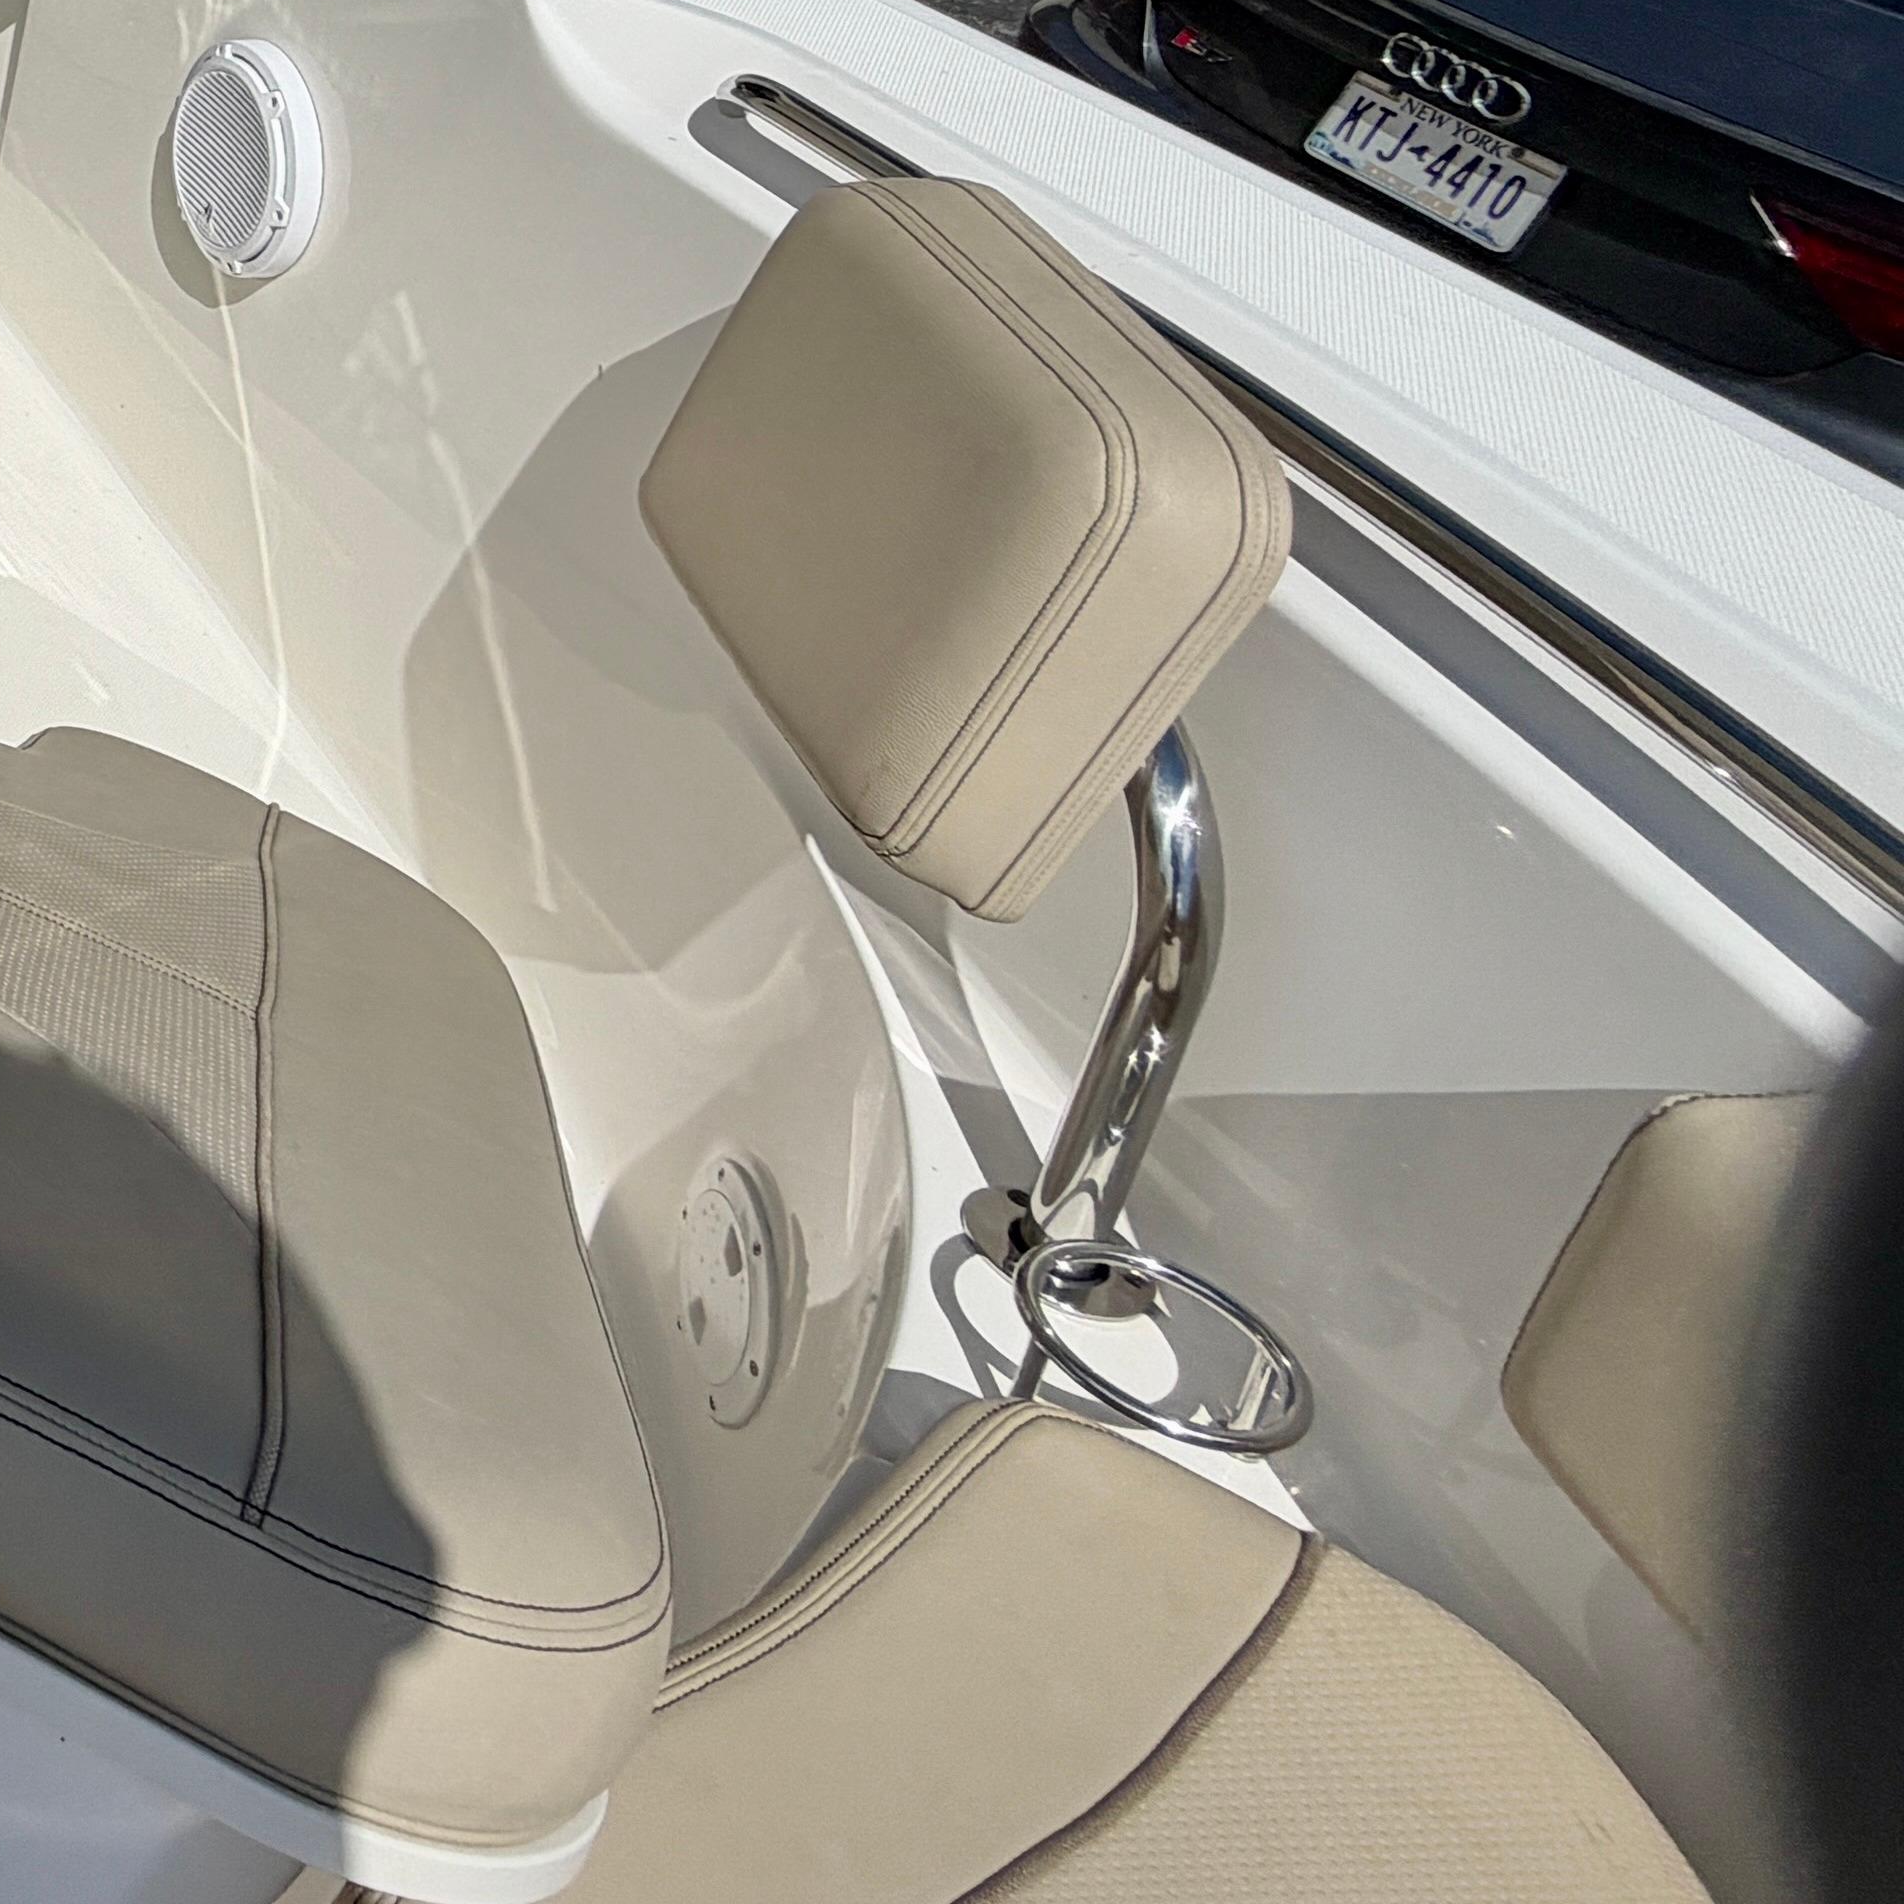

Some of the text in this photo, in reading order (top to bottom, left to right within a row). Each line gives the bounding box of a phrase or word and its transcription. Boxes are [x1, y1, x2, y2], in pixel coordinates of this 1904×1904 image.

[1332, 95, 1419, 162] KTJ
[1424, 144, 1527, 220] 4410
[1399, 98, 1509, 159] NEW YORK
